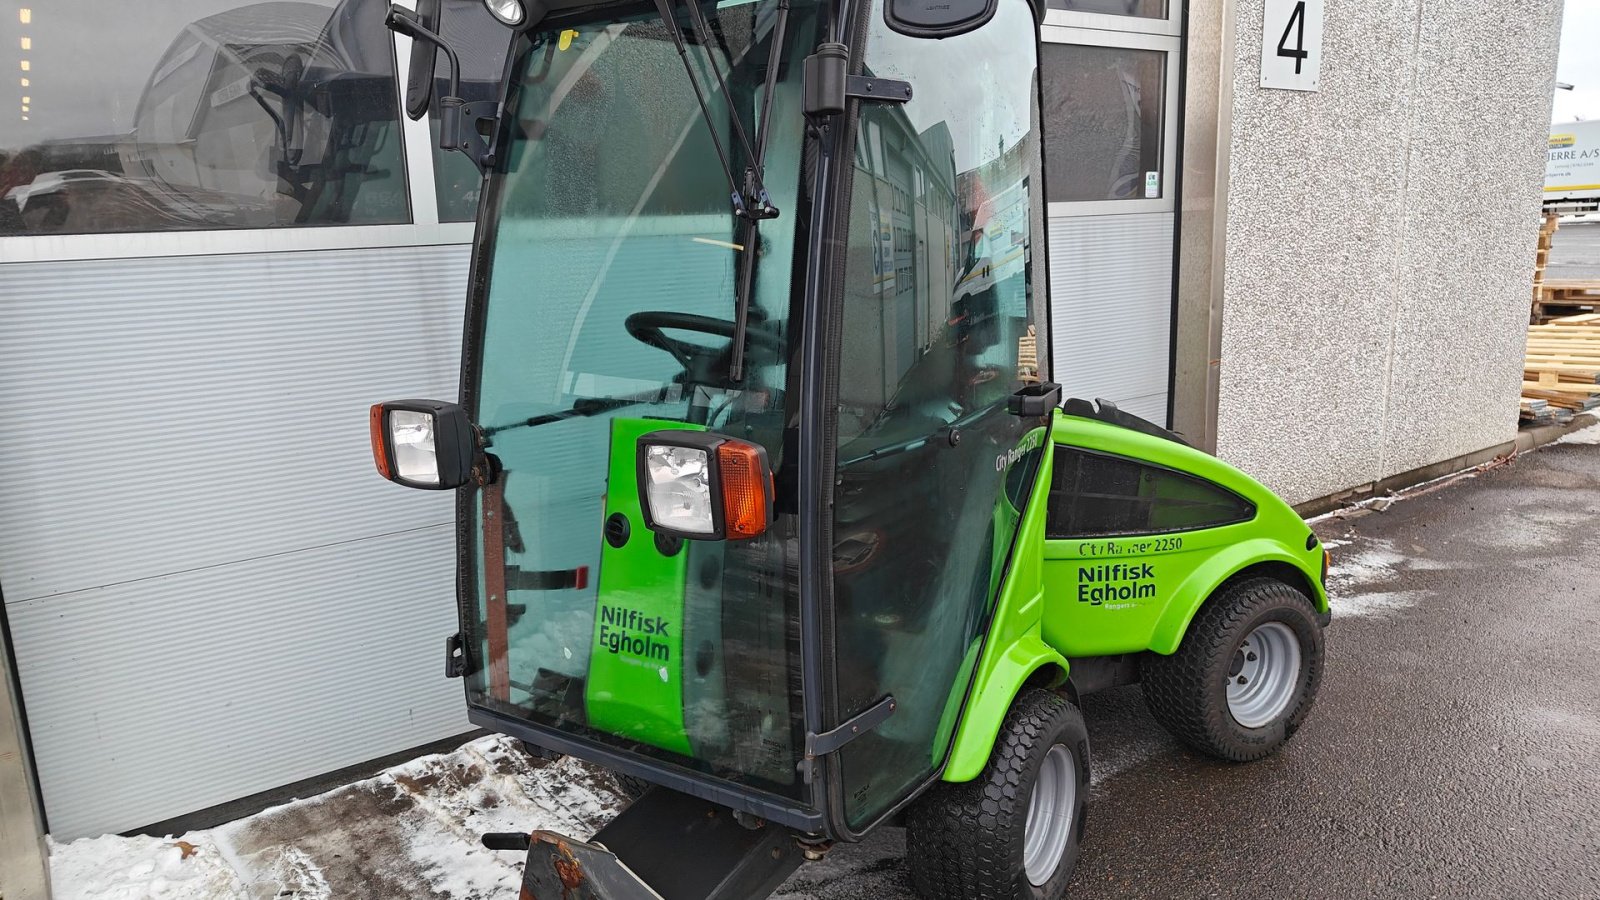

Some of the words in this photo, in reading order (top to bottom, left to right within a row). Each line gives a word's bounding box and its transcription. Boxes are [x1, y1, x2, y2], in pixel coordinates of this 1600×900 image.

[1276, 0, 1308, 75] 4
[1580, 148, 1600, 159] A/S
[996, 454, 1008, 472] City
[1007, 444, 1026, 464] Ranger
[1154, 537, 1182, 552] 2250
[1078, 563, 1155, 583] Nilfisk
[1078, 581, 1156, 606] Egholm
[601, 605, 670, 637] Nilfisk
[600, 624, 670, 662] Egholm
